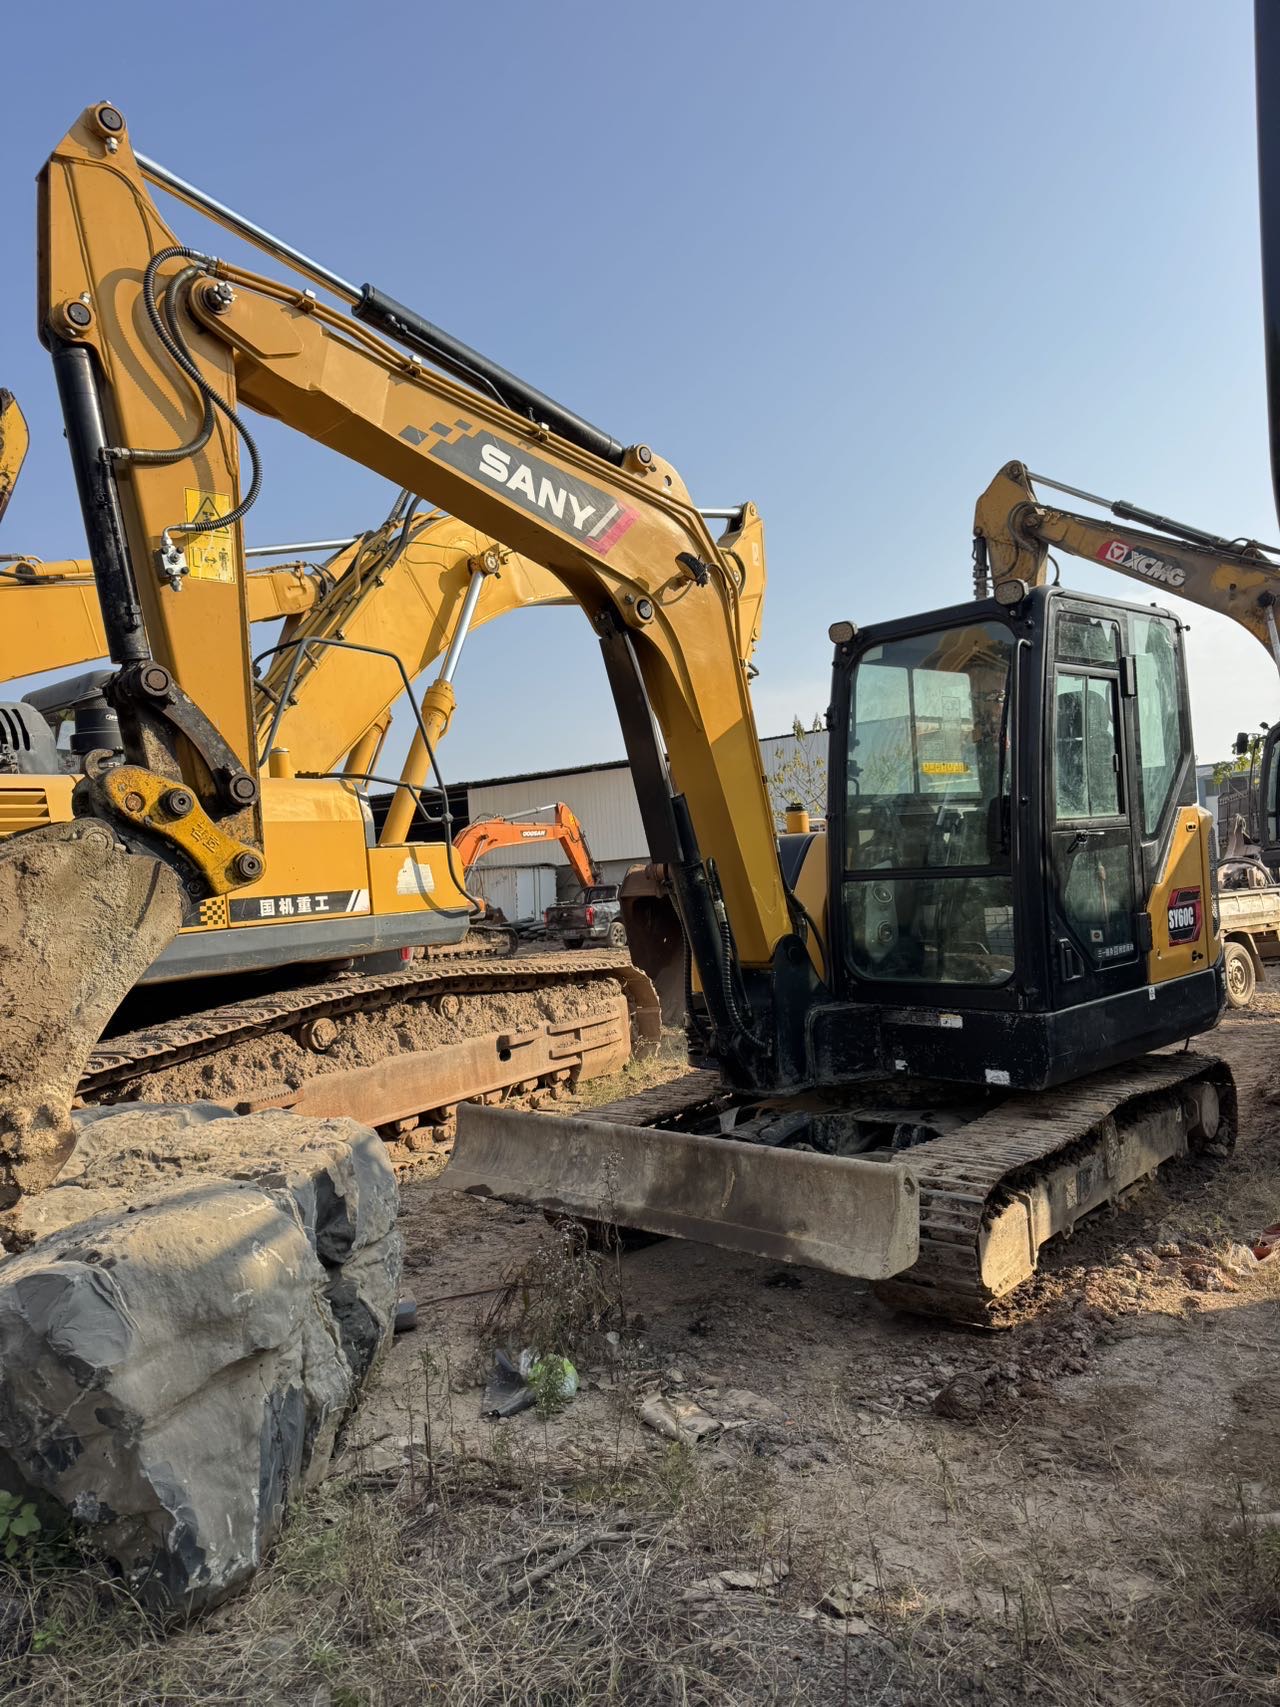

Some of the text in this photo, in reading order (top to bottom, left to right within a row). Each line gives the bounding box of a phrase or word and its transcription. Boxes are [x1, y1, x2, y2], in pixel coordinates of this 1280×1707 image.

[479, 443, 596, 531] SANY
[1121, 550, 1186, 587] XCMG
[260, 895, 329, 917] 国机重工
[1168, 906, 1194, 929] SY60C
